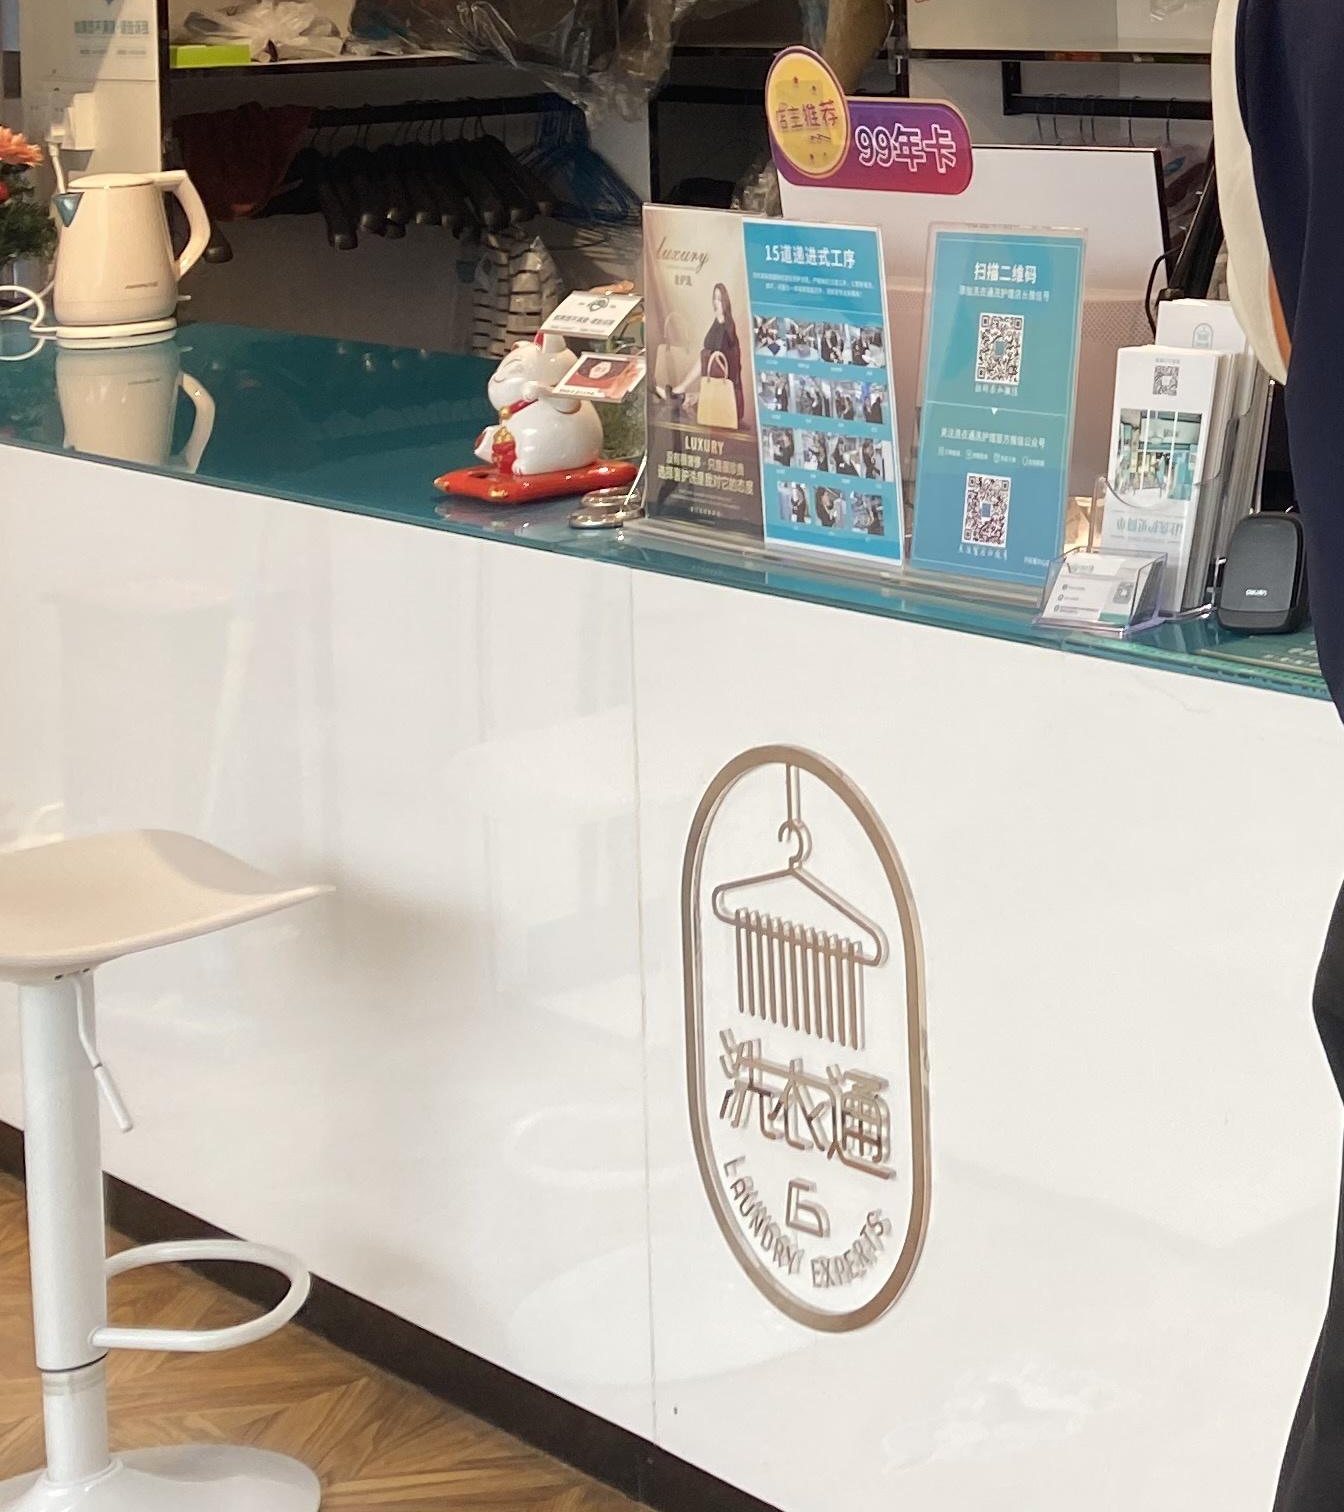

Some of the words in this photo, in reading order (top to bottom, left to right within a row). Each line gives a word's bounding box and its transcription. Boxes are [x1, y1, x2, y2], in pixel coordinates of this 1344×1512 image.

[855, 123, 957, 174] 99年卡
[974, 261, 1037, 285] 扫描二维码
[684, 435, 725, 455] LUXURY
[718, 1028, 897, 1180] 洗衣通
[723, 1155, 804, 1276] LAUNDRY
[811, 1208, 893, 1289] EXPERTS
